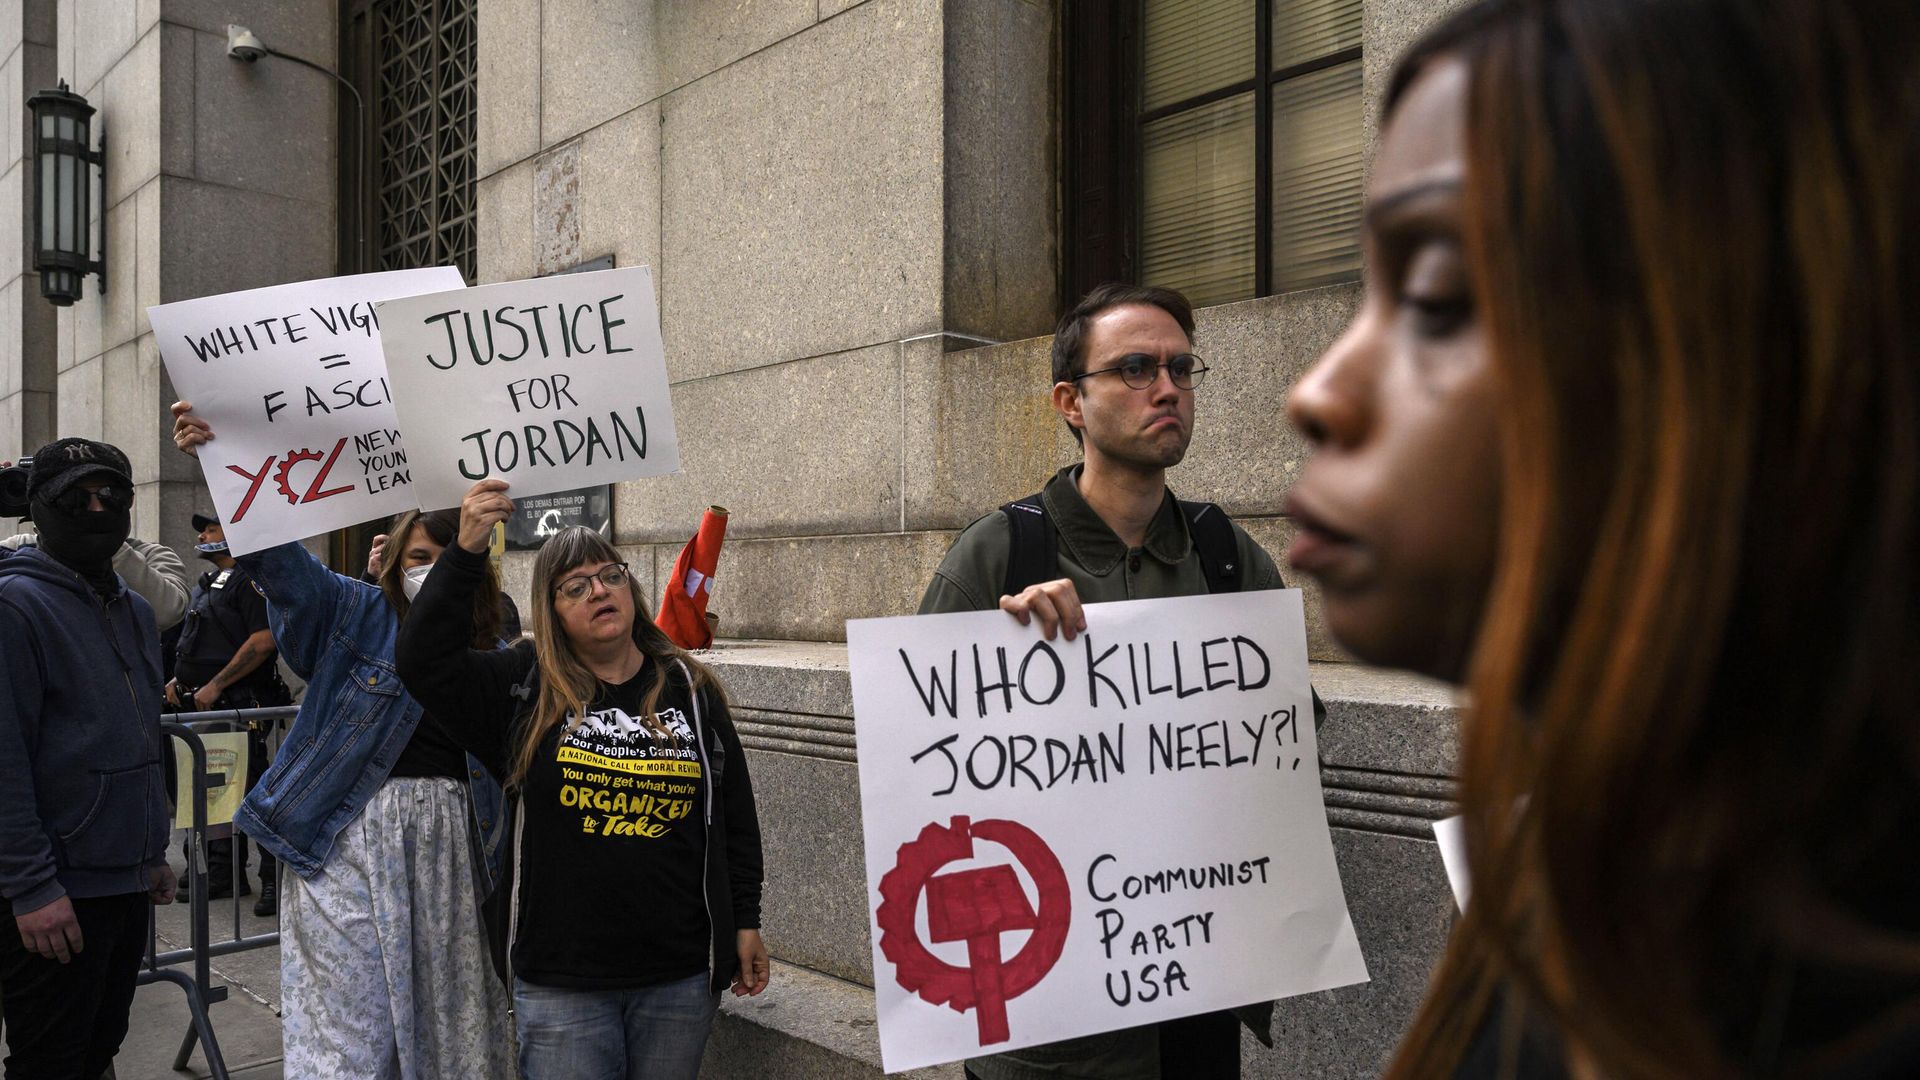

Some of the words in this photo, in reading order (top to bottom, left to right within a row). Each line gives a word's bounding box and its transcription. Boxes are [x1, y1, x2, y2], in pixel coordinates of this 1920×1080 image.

[184, 313, 308, 363] WHITE
[424, 294, 634, 370] JUSTICE
[507, 374, 579, 413] FOR
[458, 406, 647, 480] JORDAN
[523, 500, 534, 509] LOS
[574, 495, 586, 505] POR
[526, 510, 533, 519] EL
[563, 506, 583, 516] STREET
[898, 640, 1067, 719] WHO
[1085, 633, 1272, 710] KILLED
[559, 749, 566, 759] A
[567, 750, 608, 766] NATIONAL
[610, 761, 630, 770] CALL
[633, 763, 644, 771] for
[646, 763, 676, 774] MORAL
[564, 734, 593, 749] Poor
[595, 743, 646, 758] People's
[910, 722, 1126, 797] JORDAN
[1149, 704, 1301, 775] NEELY?!
[560, 784, 693, 821] ORGANIZED
[562, 767, 584, 780] You
[586, 773, 612, 786] only
[612, 776, 633, 788] get
[636, 780, 666, 792] what
[668, 783, 696, 795] you're
[581, 815, 600, 830] to
[602, 814, 672, 838] Take
[1087, 854, 1271, 903] COMMUNIST
[1095, 908, 1214, 959] PARTY
[1105, 960, 1190, 1007] USA
